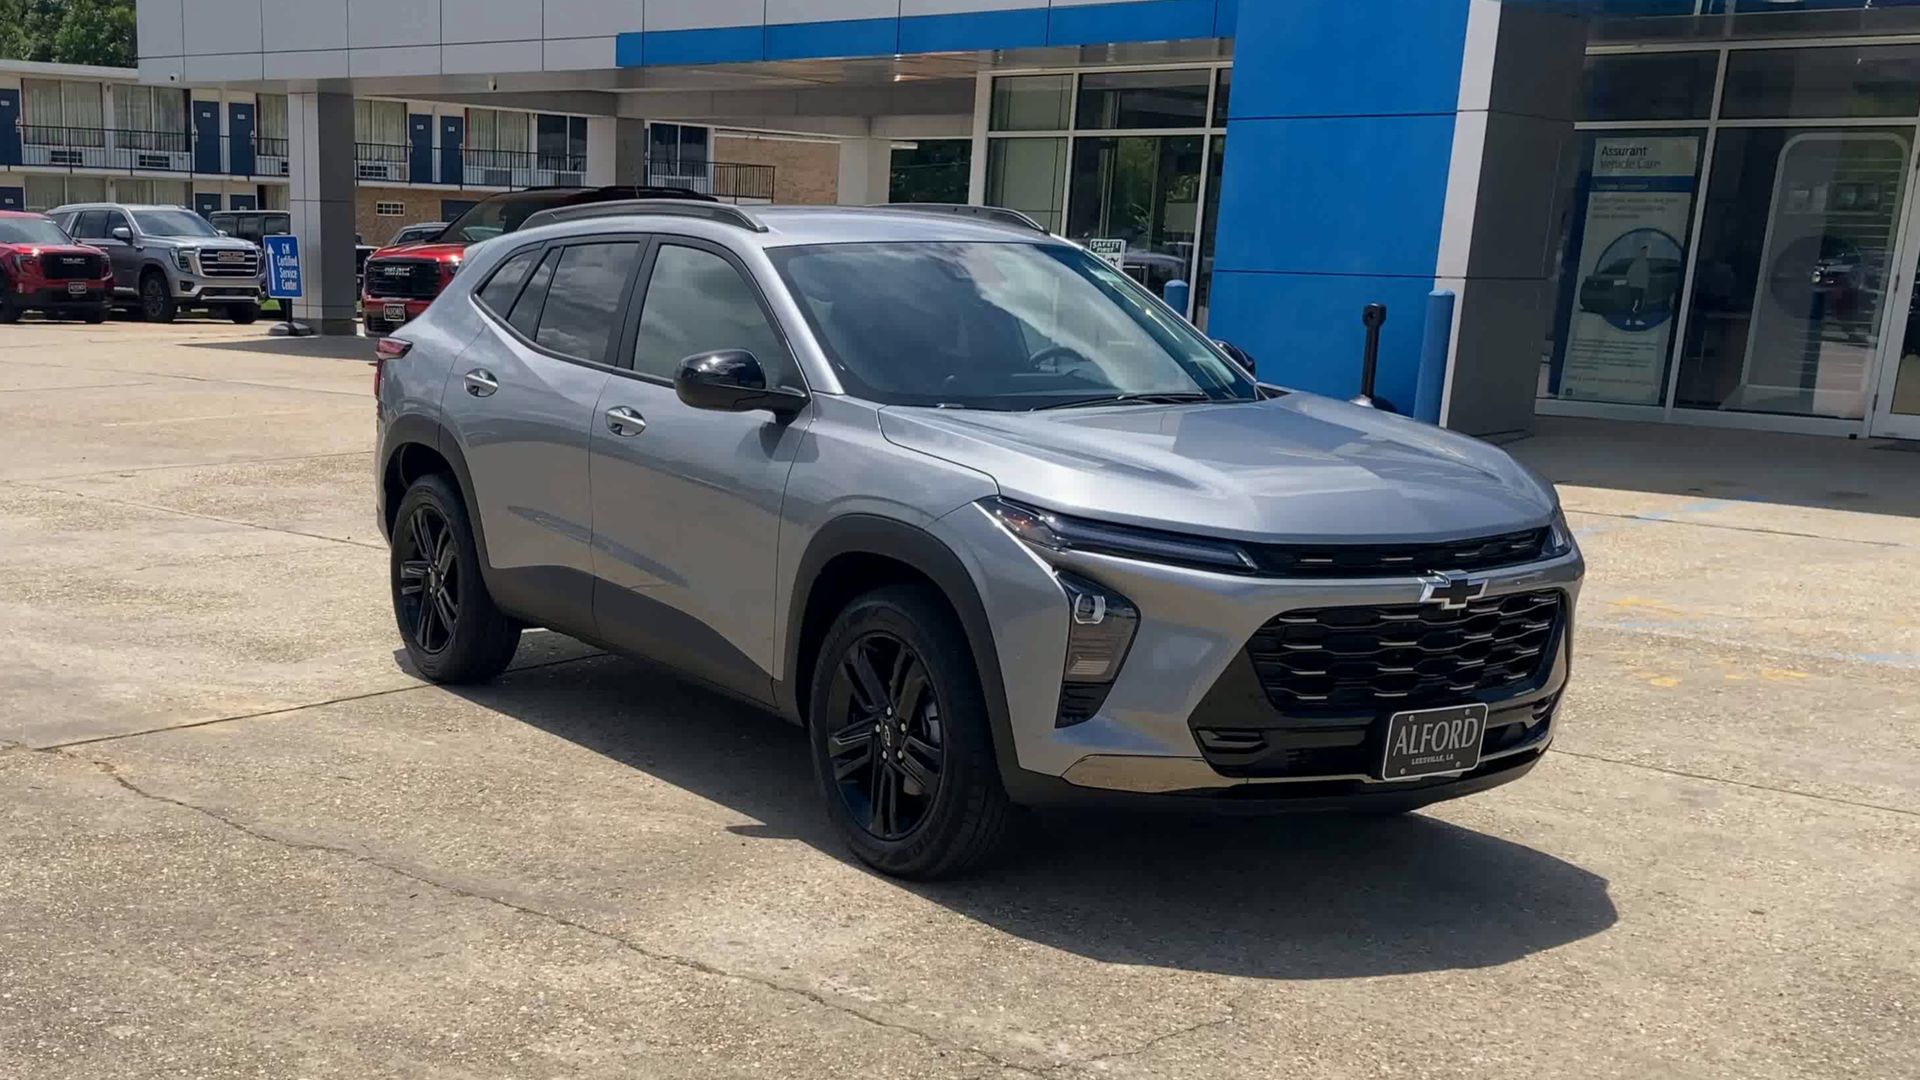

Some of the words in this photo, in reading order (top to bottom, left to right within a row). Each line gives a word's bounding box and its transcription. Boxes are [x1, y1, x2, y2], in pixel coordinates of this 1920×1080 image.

[1601, 146, 1648, 157] Assurant
[277, 255, 298, 267] Certified
[280, 267, 298, 279] Service
[281, 279, 298, 290] Center
[1392, 718, 1479, 757] ALFORD
